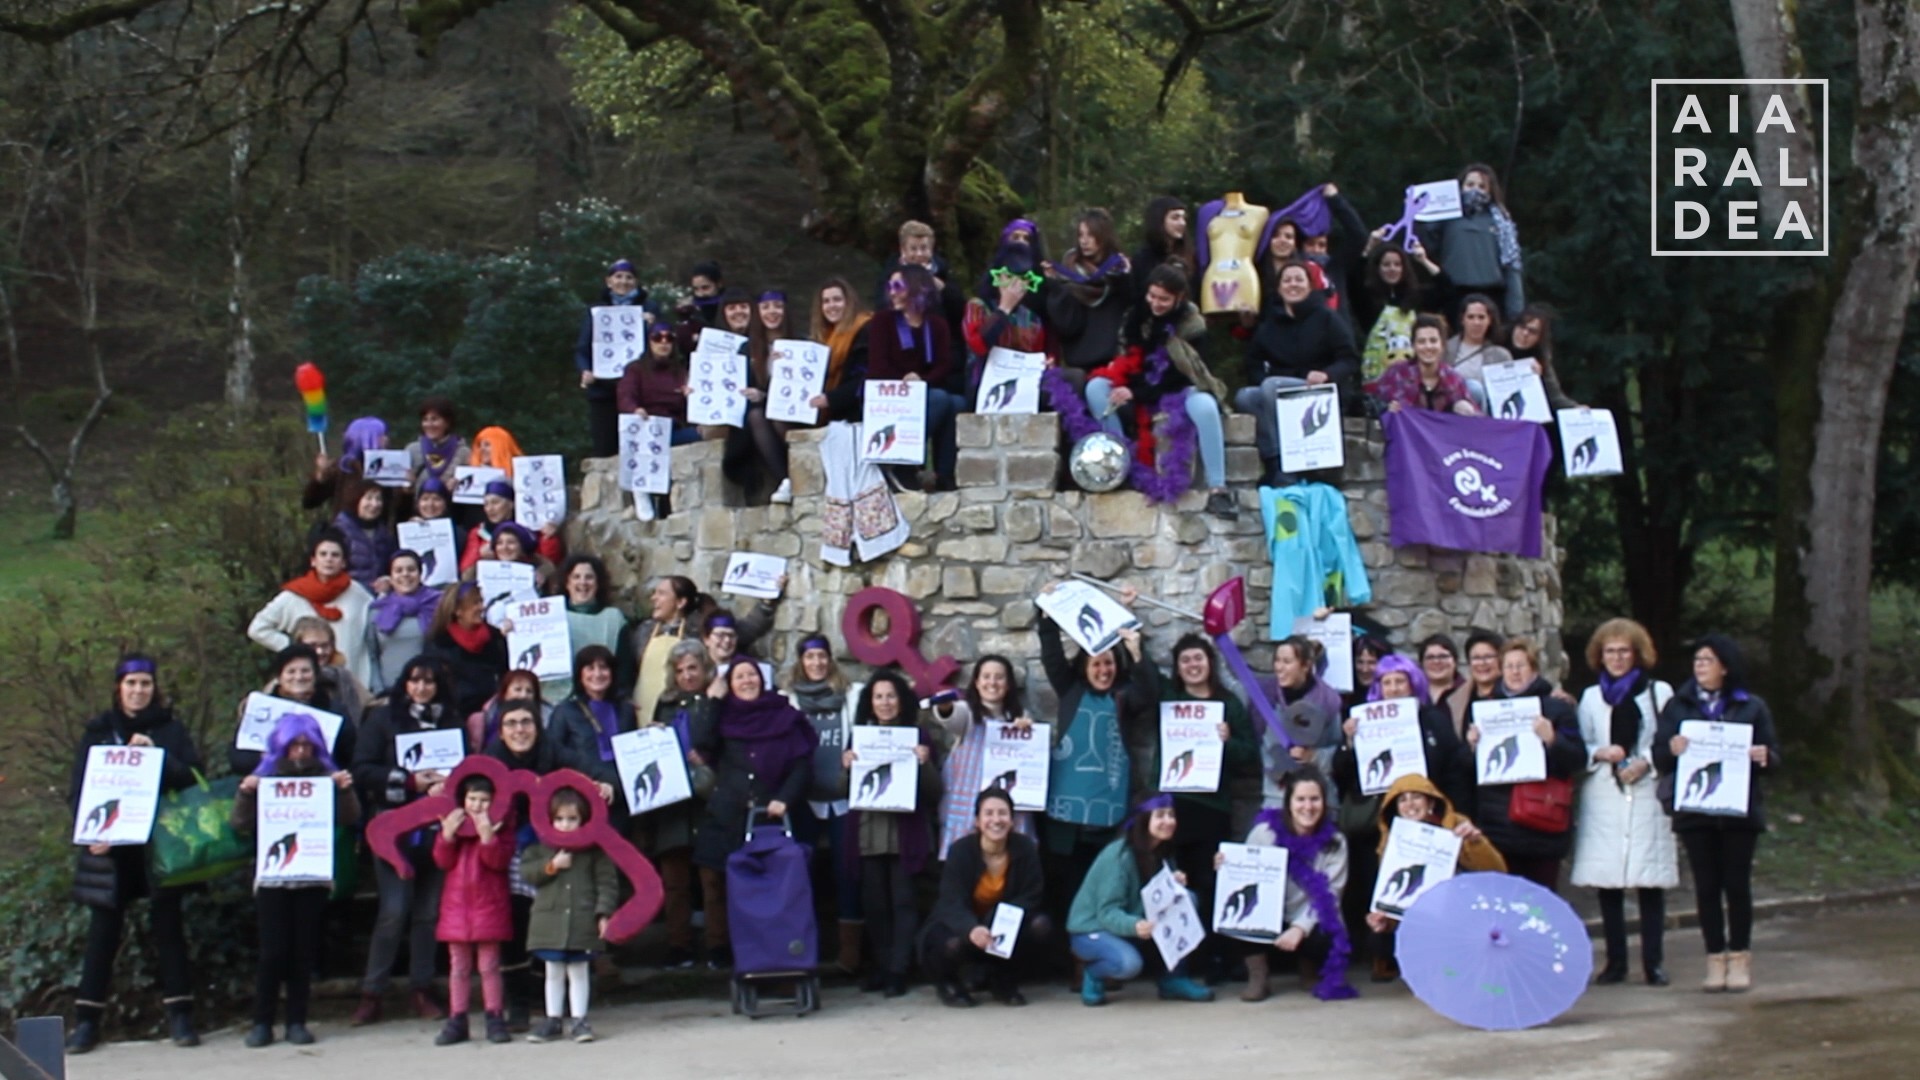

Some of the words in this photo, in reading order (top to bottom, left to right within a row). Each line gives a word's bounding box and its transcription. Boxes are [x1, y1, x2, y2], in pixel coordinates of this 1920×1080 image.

[878, 383, 910, 397] M8
[519, 601, 550, 617] M8
[1174, 704, 1206, 719] M8
[1365, 704, 1400, 721] M8
[104, 750, 143, 767] M8
[275, 781, 313, 798] M8
